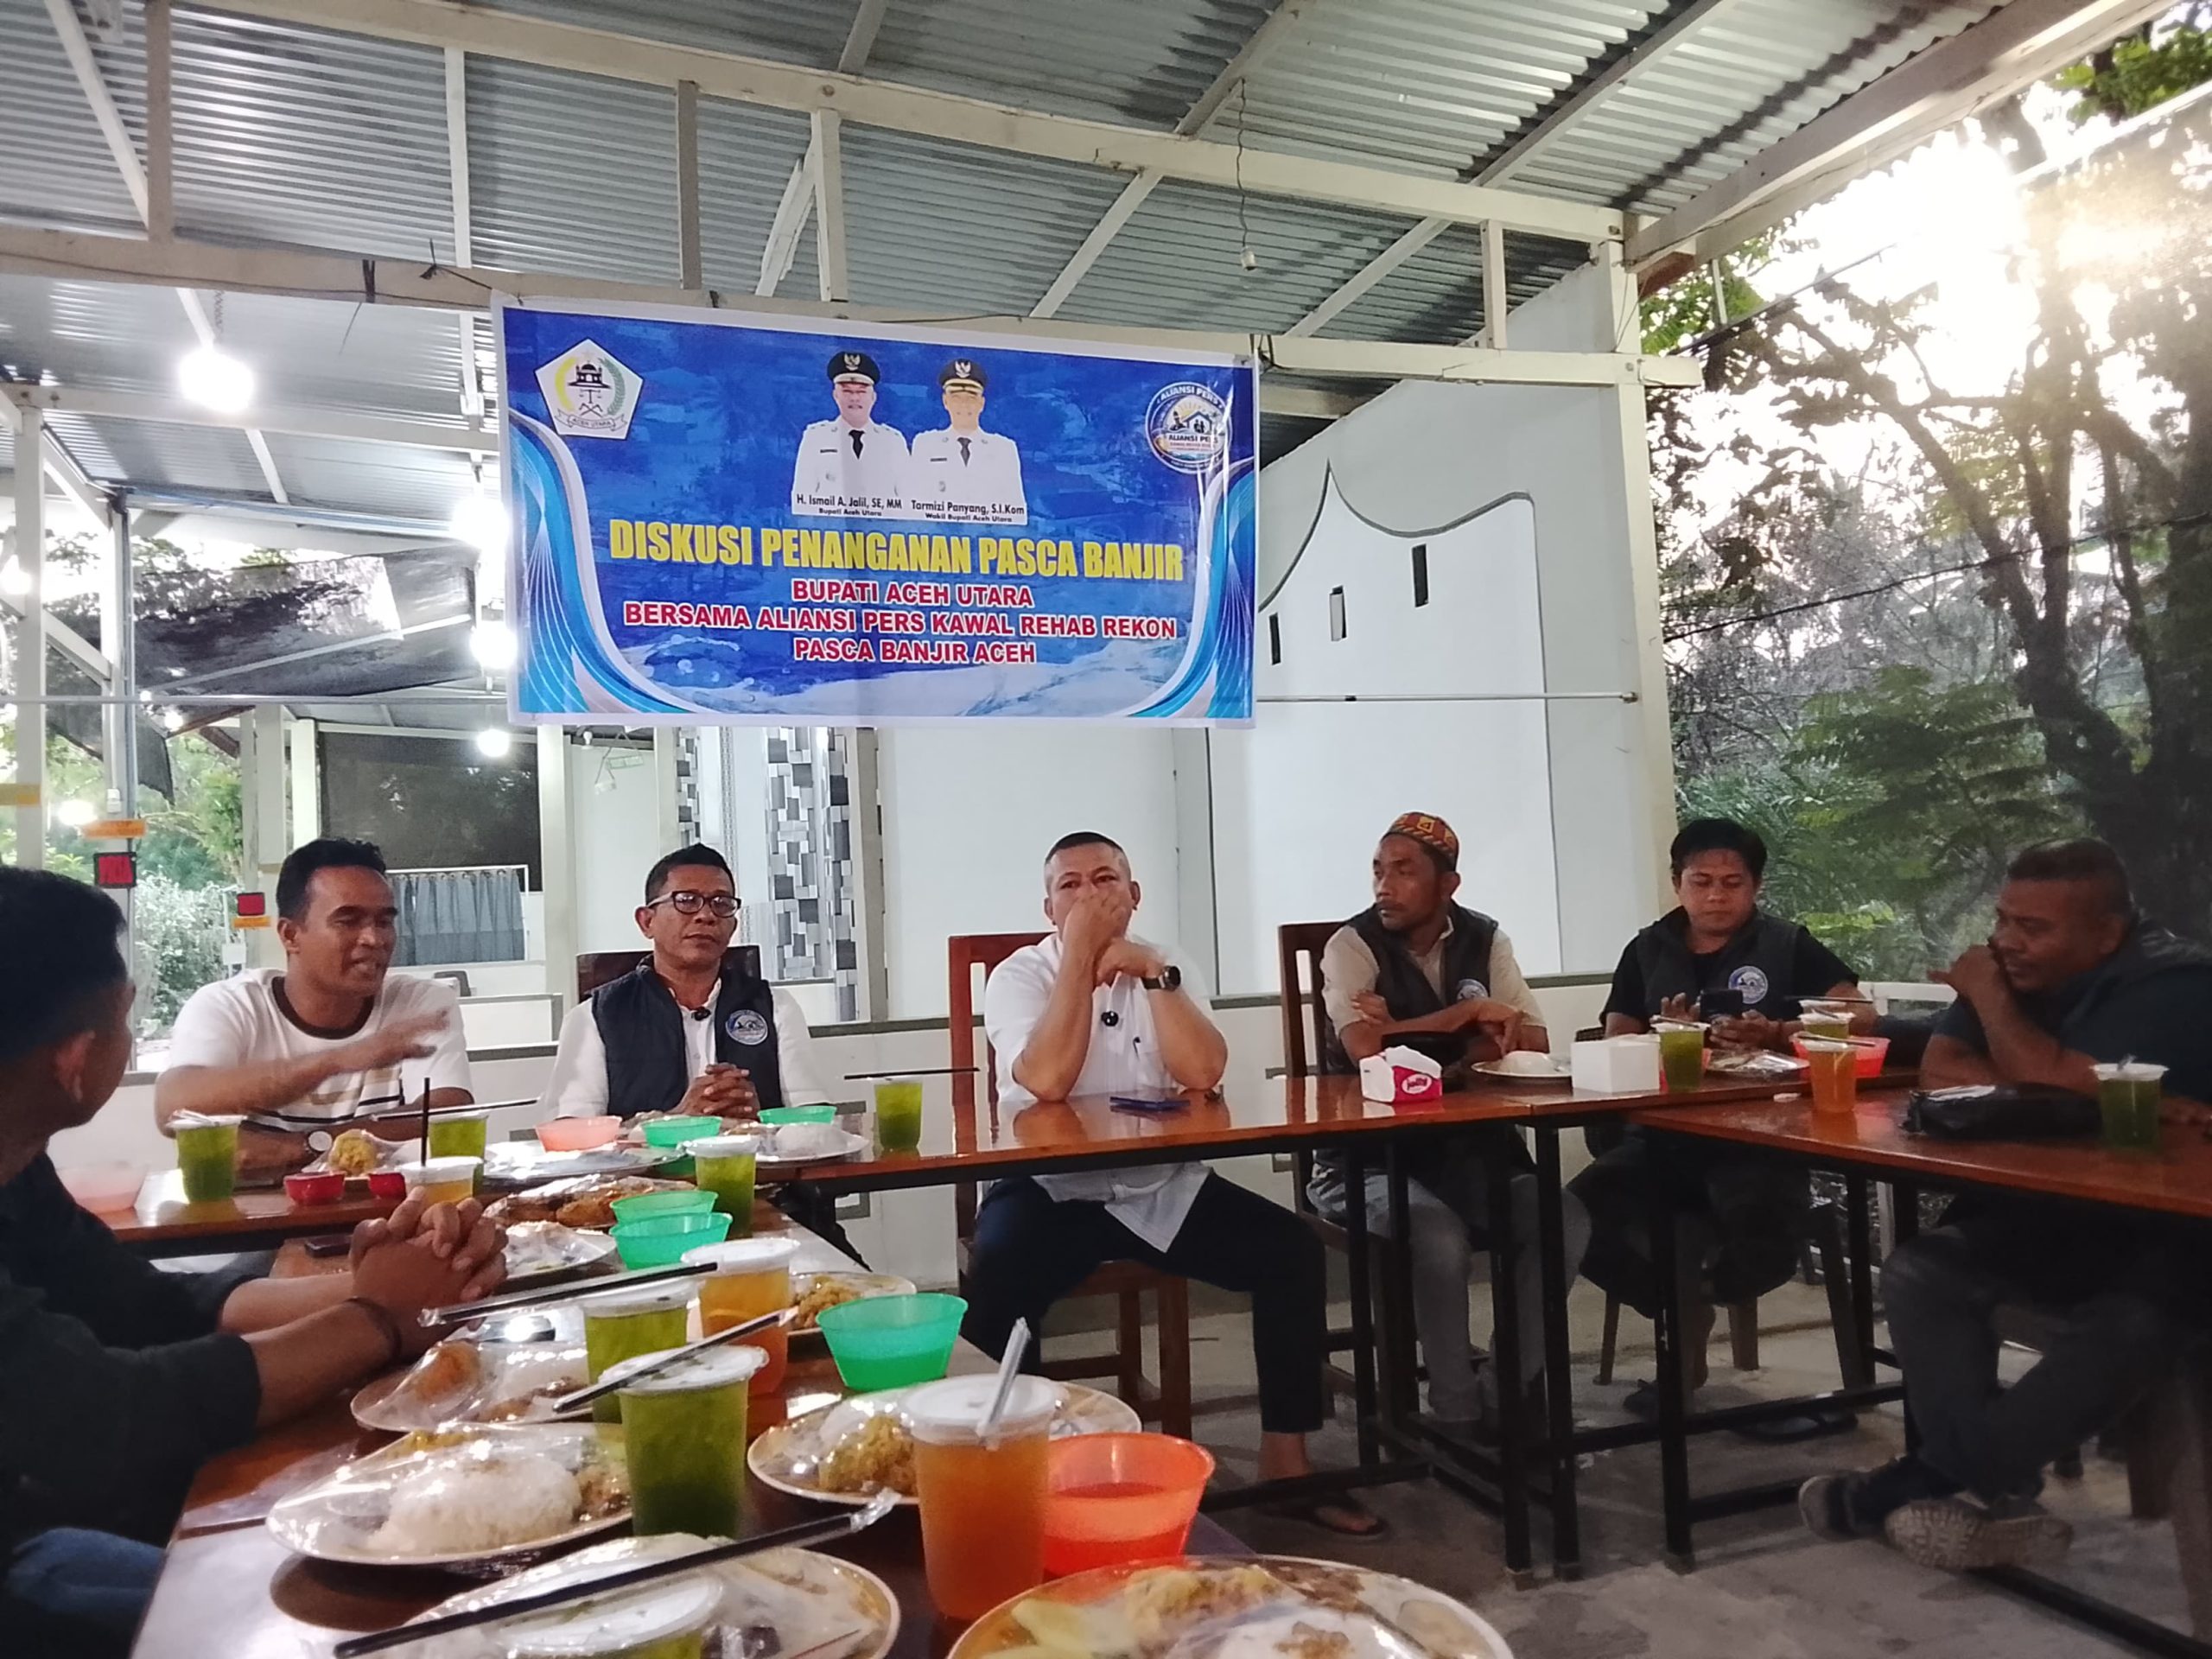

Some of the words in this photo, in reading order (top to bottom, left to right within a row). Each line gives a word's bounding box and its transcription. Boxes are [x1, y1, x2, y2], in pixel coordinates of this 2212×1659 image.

[1160, 385, 1195, 400] ALIANSI
[1197, 387, 1218, 405] PERS
[797, 493, 806, 505] H.
[809, 495, 836, 506] Ismail
[837, 495, 847, 506] A.
[849, 497, 869, 508] Jalil,
[871, 498, 885, 510] SE,
[887, 499, 902, 509] MM
[818, 507, 842, 516] Bupati
[911, 499, 944, 512] Tarmizi
[947, 501, 989, 515] Panyang,
[991, 503, 1025, 514] S.I.Kom
[609, 518, 753, 566] DISKUSI
[760, 528, 972, 574] PENANGANAN
[978, 537, 1078, 577] PASCA
[1083, 541, 1184, 582] BANJIR
[791, 580, 878, 603] BUPATI
[885, 582, 950, 605] ACEH
[957, 585, 1035, 607] UTARA
[623, 601, 752, 629] BERSAMA
[757, 606, 858, 632] ALIANSI
[862, 610, 925, 633] PERS
[931, 613, 1014, 635] KAWAL
[1020, 614, 1096, 638] REHAB
[1103, 616, 1177, 639] REKON
[793, 637, 874, 661] PASCA
[880, 640, 969, 663] BANJIR
[973, 642, 1036, 664] ACEH
